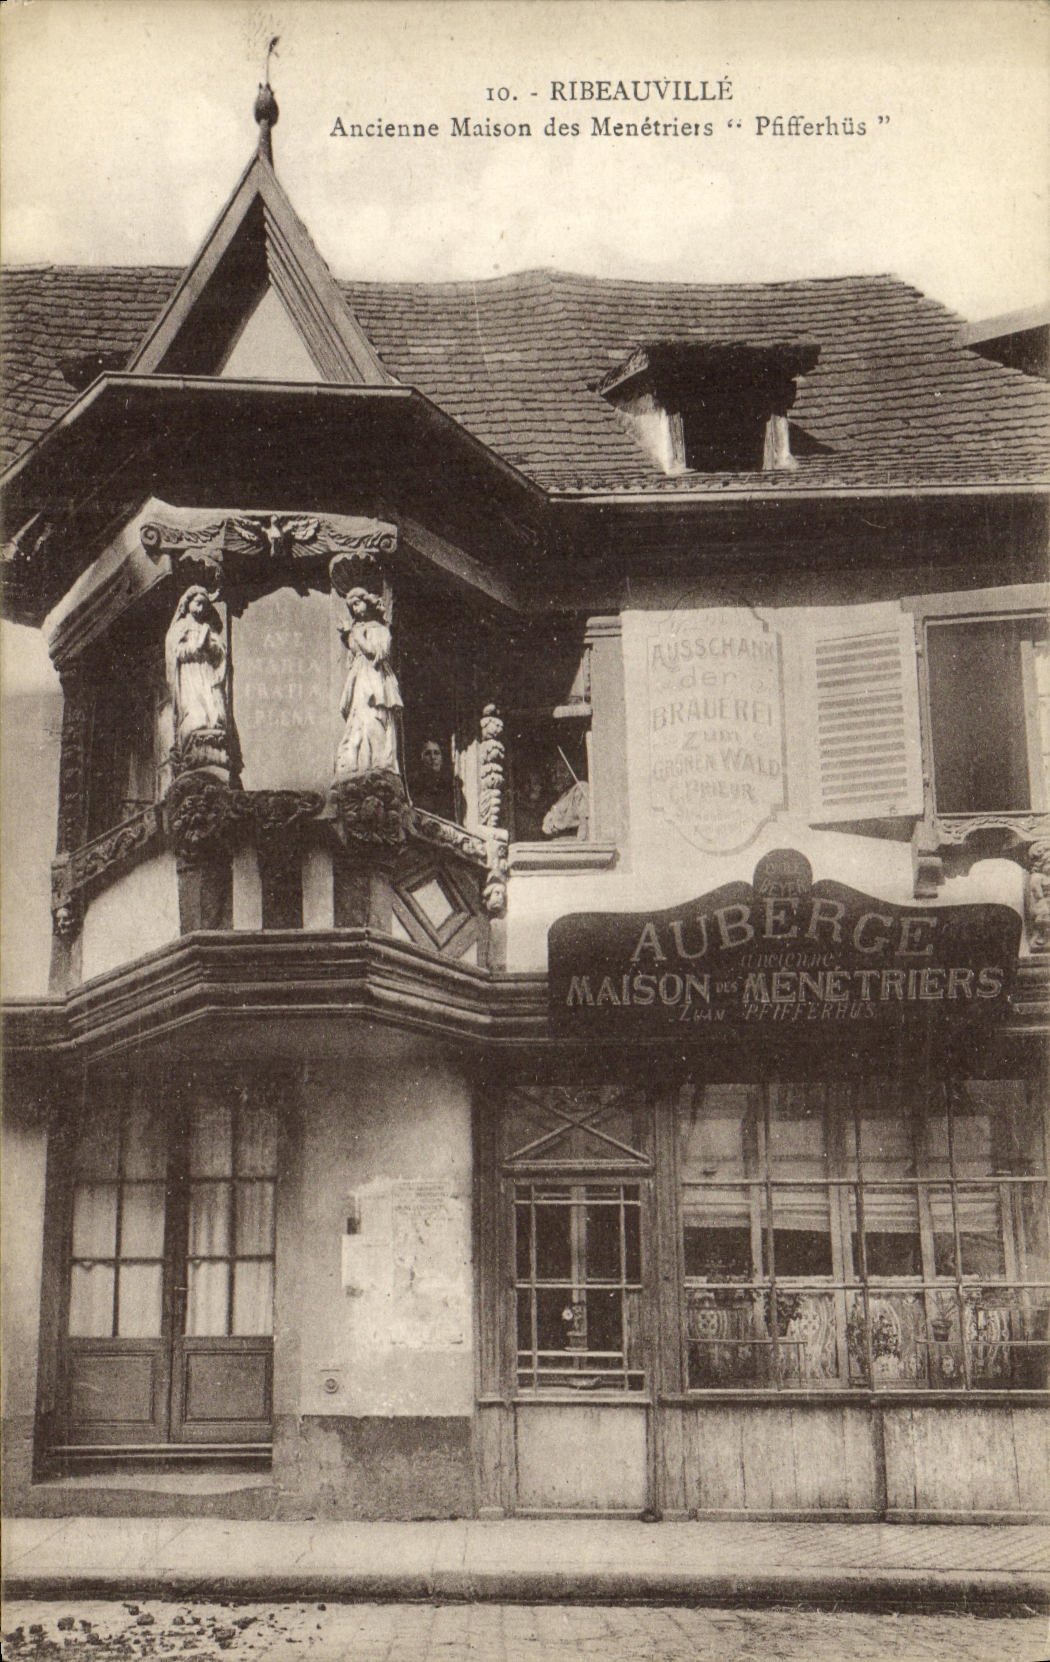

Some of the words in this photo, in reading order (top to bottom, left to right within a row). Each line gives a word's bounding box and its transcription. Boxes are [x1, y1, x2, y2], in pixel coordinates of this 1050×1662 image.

[679, 666, 738, 689] der
[652, 697, 773, 732] BRAUEREI
[630, 897, 938, 961] AUBERGE
[566, 973, 711, 1006] MAISON
